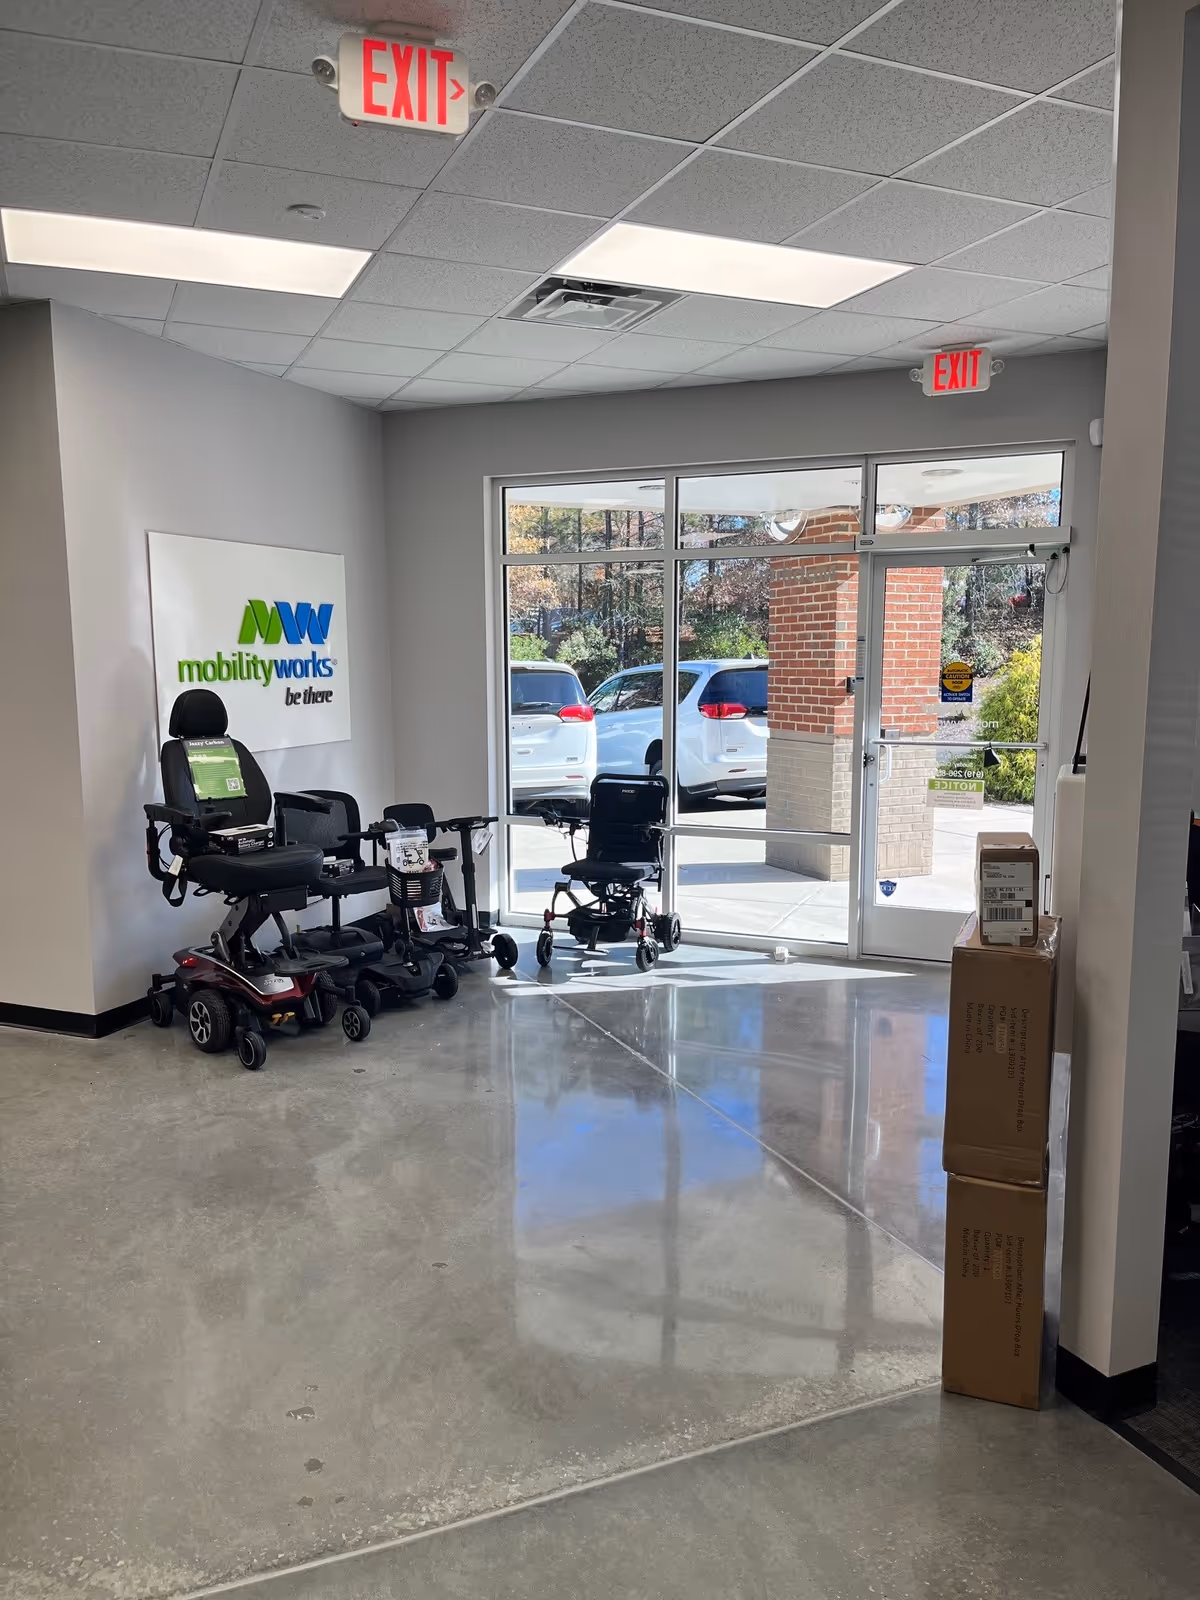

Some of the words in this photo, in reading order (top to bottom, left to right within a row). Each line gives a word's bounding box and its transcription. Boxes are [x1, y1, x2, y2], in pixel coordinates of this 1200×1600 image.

[363, 39, 454, 125] EXIT
[934, 349, 983, 391] EXIT
[285, 687, 302, 706] be
[303, 686, 333, 704] there
[965, 1001, 974, 1024] Made
[964, 1033, 973, 1054] China
[1018, 1055, 1026, 1076] After
[1016, 1100, 1025, 1117] Drop
[1016, 1119, 1024, 1132] Box
[961, 1257, 969, 1278] China
[1016, 1281, 1024, 1302] After
[1014, 1302, 1023, 1324] Hours
[1013, 1324, 1022, 1343] Drop
[1013, 1343, 1021, 1358] Box
